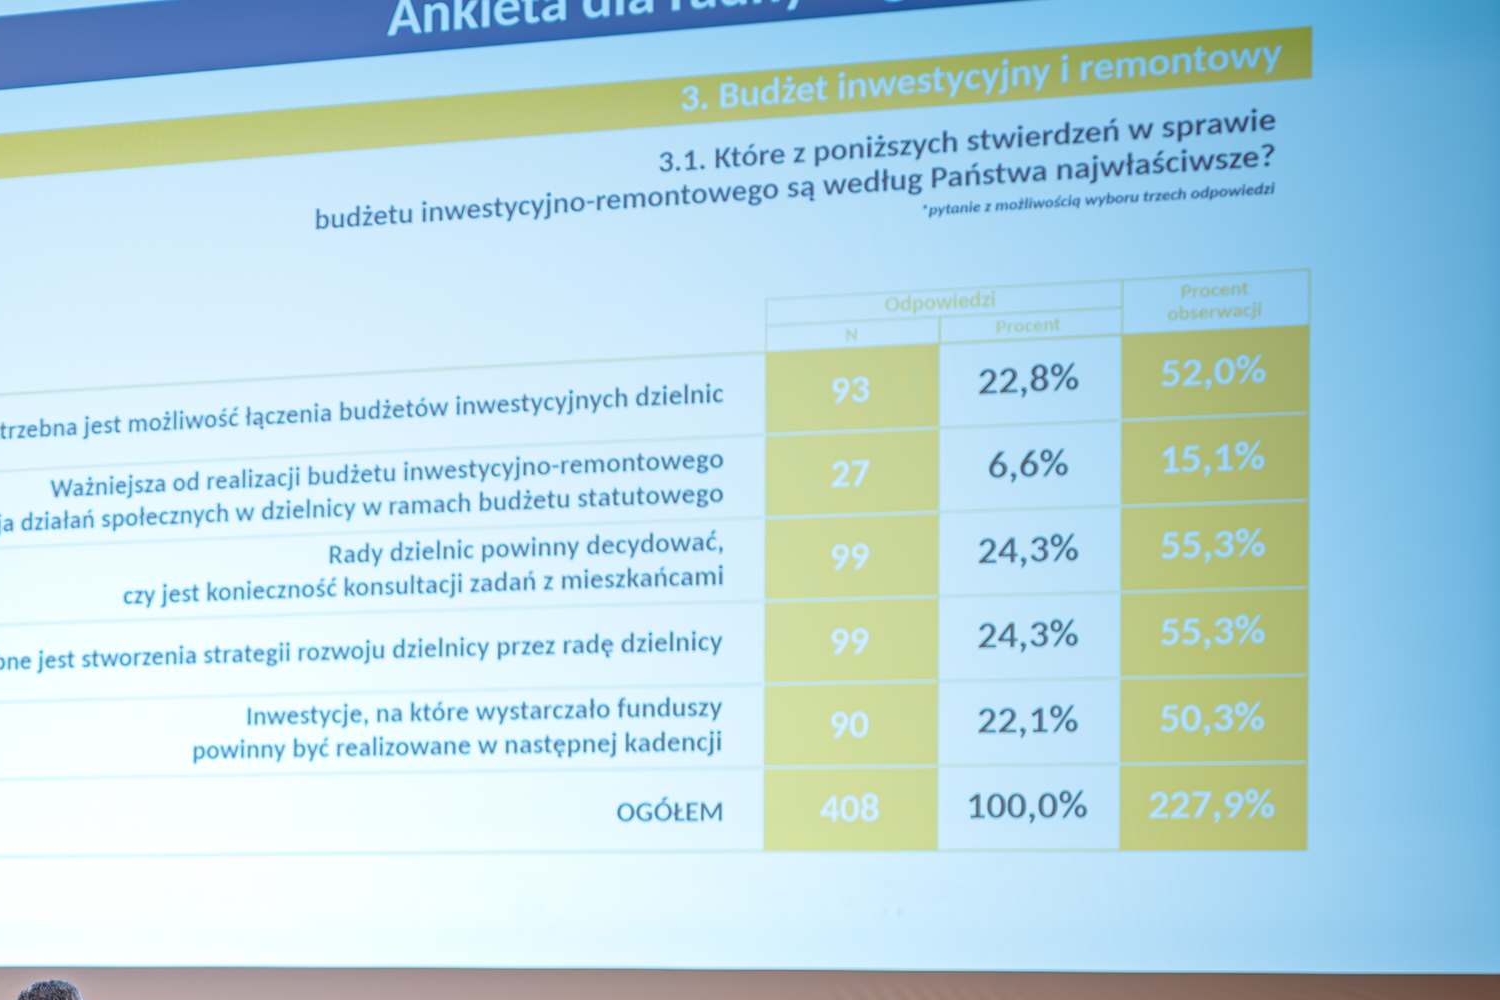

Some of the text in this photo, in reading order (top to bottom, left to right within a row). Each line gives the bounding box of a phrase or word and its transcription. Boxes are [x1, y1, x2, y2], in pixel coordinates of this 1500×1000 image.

[681, 45, 1283, 112] 3. Budżet inwestycyjny i remontowy
[660, 106, 1275, 173] 3.1. Które z poniższych stwierdzeń w sprawie
[316, 142, 1275, 230] budżetu inwestycyjno-remontowego są według Państwa najwłaściwsze?
[985, 201, 991, 212] z
[995, 193, 1080, 212] możliwością
[1085, 191, 1139, 207] wyboru
[1144, 186, 1186, 203] trzech
[1190, 181, 1275, 201] odpowiedzi
[885, 290, 996, 313] Odpowiedzi
[1181, 282, 1249, 299] Procent
[996, 318, 1060, 334] Procent
[1167, 302, 1262, 321] obserwacji
[845, 328, 858, 341] N
[980, 363, 1078, 397] 22,8%
[1161, 354, 1266, 390] 52,0%
[832, 376, 870, 404] 93
[83, 414, 121, 440] jest
[129, 405, 238, 432] możliwość
[246, 401, 331, 430] łączenia
[340, 396, 448, 422] budżetów
[456, 385, 628, 416] inwestycyjnych
[636, 382, 723, 407] dzielnic
[51, 452, 723, 499] Ważniejsza od realizacji budżetu inwestycyjno-remontowego
[831, 459, 870, 488] 27
[989, 449, 1068, 482] 6,6%
[1162, 441, 1265, 477] 15,1%
[21, 508, 94, 532] działań
[102, 501, 228, 532] społecznych
[236, 505, 254, 522] w
[262, 497, 355, 521] dzielnicy
[363, 500, 382, 516] w
[390, 491, 470, 515] ramach
[480, 488, 569, 512] budżetu
[578, 486, 723, 508] statutowego
[330, 528, 723, 567] Rady dzielnic powinny decydować,
[831, 543, 869, 571] 99
[979, 534, 1078, 567] 24,3%
[1161, 528, 1266, 563] 55,3%
[124, 563, 723, 608] czy jest konieczność konsultacji zadań z mieszkańcami
[831, 628, 869, 655] 99
[979, 619, 1078, 652] 24,3%
[1161, 614, 1265, 650] 55,3%
[37, 649, 74, 674] jest
[82, 644, 196, 668] stworzenia
[204, 640, 290, 667] strategii
[298, 638, 384, 665] rozwoju
[393, 635, 489, 661] dzielnicy
[498, 639, 555, 660] przez
[564, 632, 613, 659] radę
[621, 629, 722, 656] dzielnicy
[247, 696, 722, 729] Inwestycje, na które wystarczało funduszy
[830, 711, 869, 739] 90
[979, 705, 1078, 737] 22,1%
[1161, 701, 1265, 736] 50,3%
[193, 729, 721, 764] powinny być realizowane w następnej kadencji
[617, 795, 722, 822] OGÓŁEM
[820, 792, 879, 822] 408
[970, 791, 1087, 823] 100,0%
[1149, 789, 1275, 823] 227,9%
